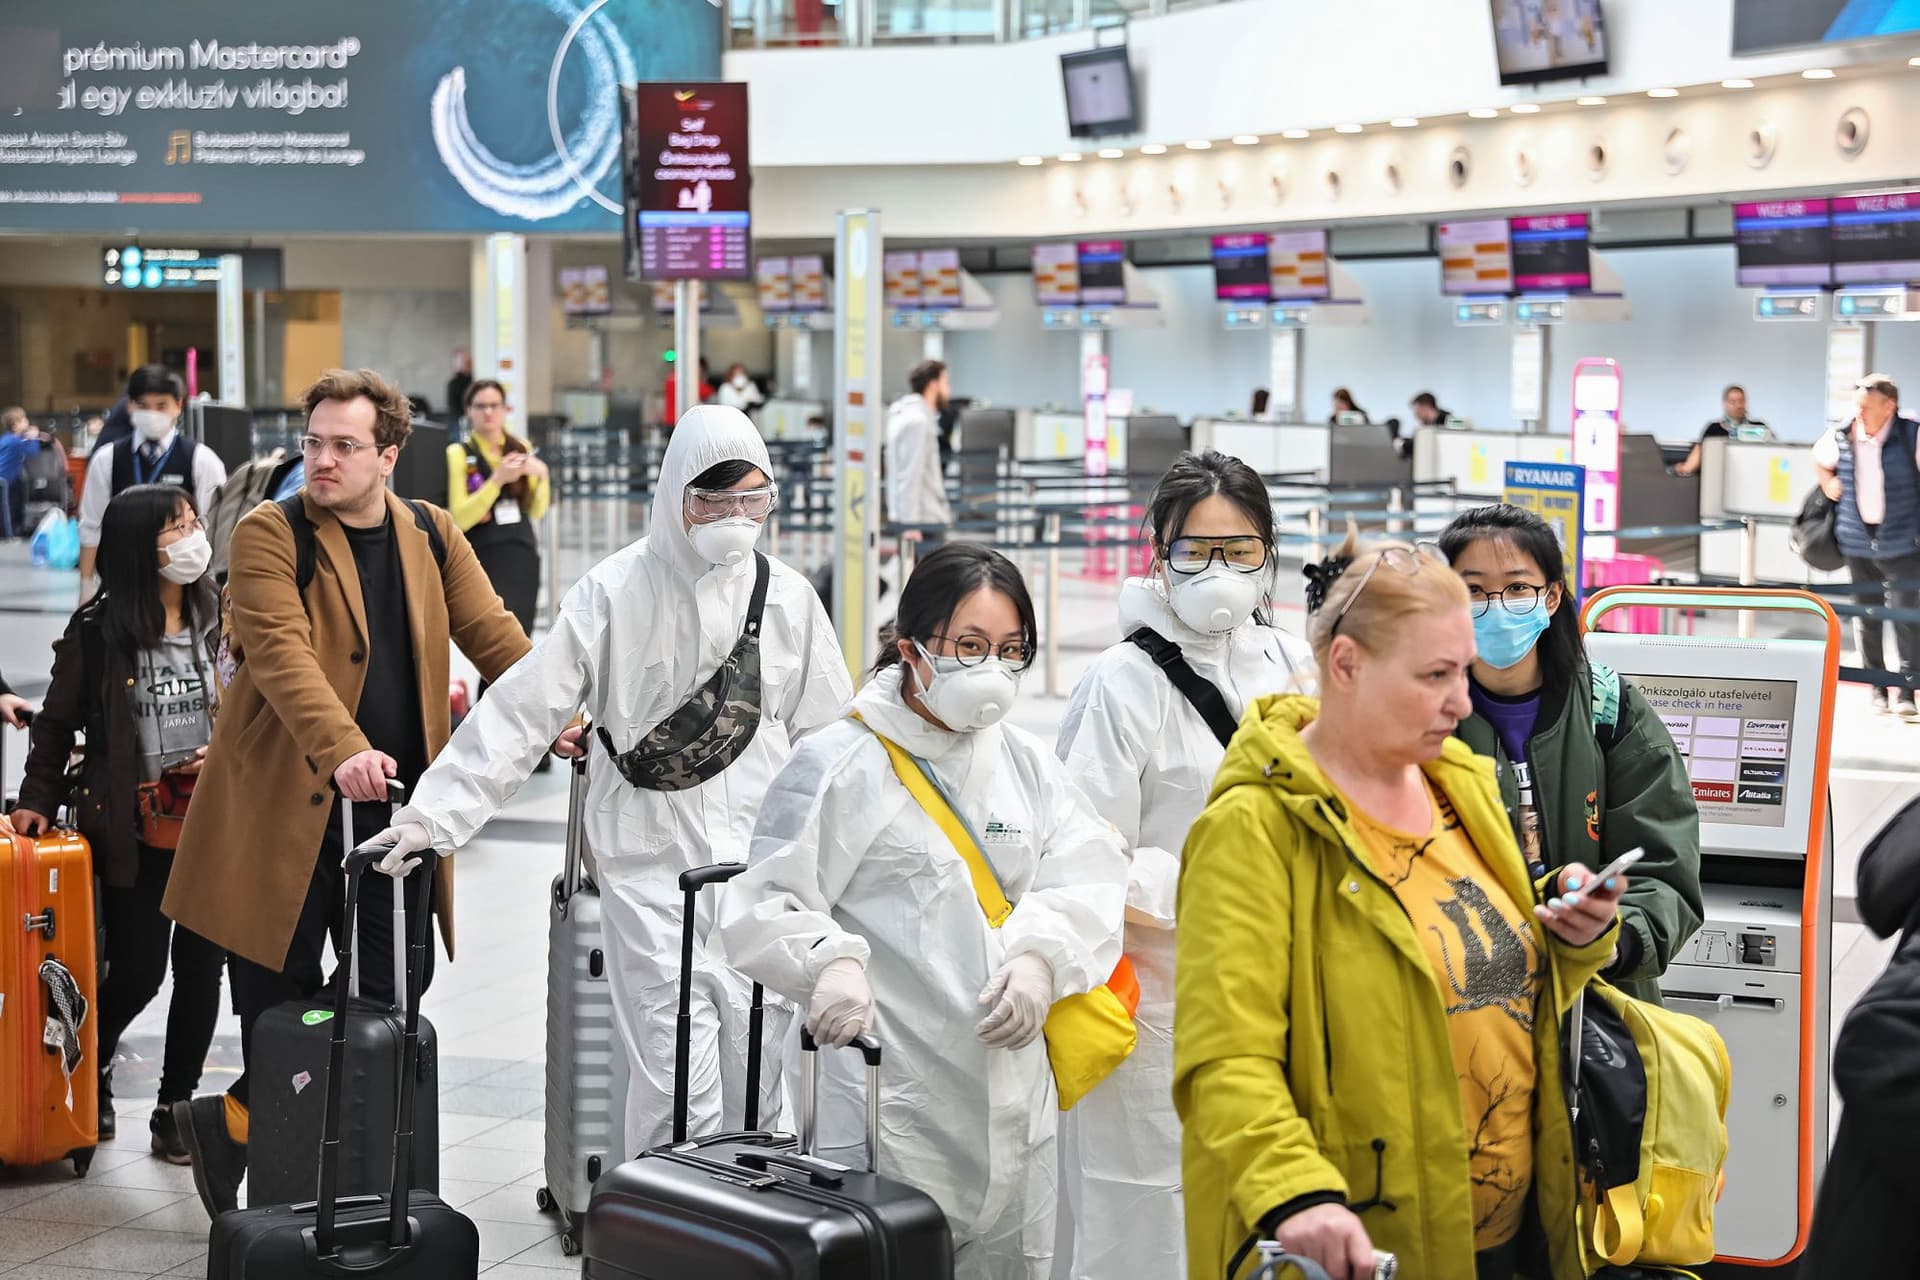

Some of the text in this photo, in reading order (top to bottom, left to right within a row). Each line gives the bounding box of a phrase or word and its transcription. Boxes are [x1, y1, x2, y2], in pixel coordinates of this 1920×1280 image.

[63, 40, 185, 77] prémium
[81, 85, 132, 115] egy
[135, 78, 239, 110] exkluzív
[241, 78, 349, 115] világba!
[1855, 198, 1885, 211] WIZZ
[1514, 467, 1576, 487] RYANAIR
[1708, 688, 1772, 702] utasfelvétel
[1671, 698, 1701, 710] check
[1704, 700, 1715, 709] in
[1718, 700, 1743, 711] here
[163, 716, 197, 729] JAPAN
[1692, 787, 1731, 798] Emirates
[1739, 789, 1772, 799] Alitalia
